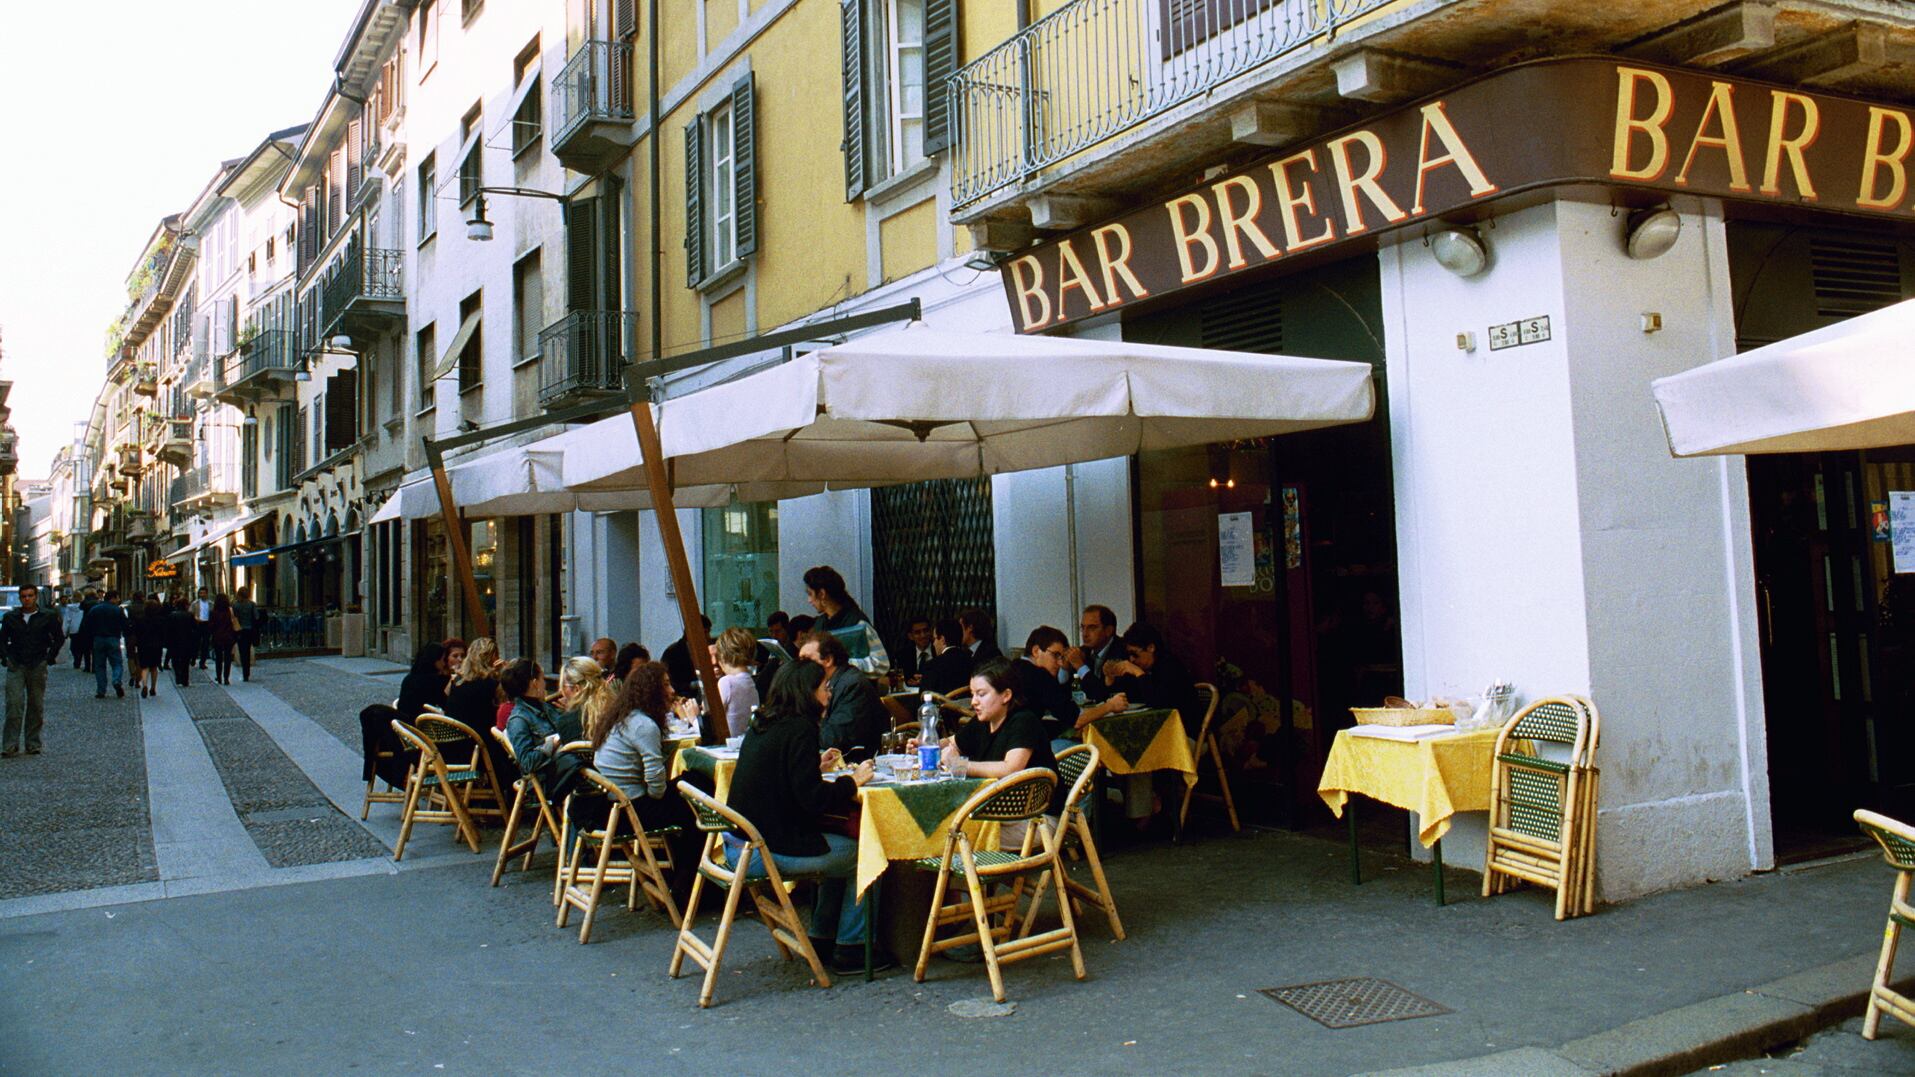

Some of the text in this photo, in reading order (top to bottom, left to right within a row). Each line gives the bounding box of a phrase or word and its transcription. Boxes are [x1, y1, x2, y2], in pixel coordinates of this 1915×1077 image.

[1609, 66, 1915, 210] BAR B
[1008, 100, 1499, 333] BAR BRERA
[1500, 328, 1508, 339] S
[1531, 321, 1539, 333] S
